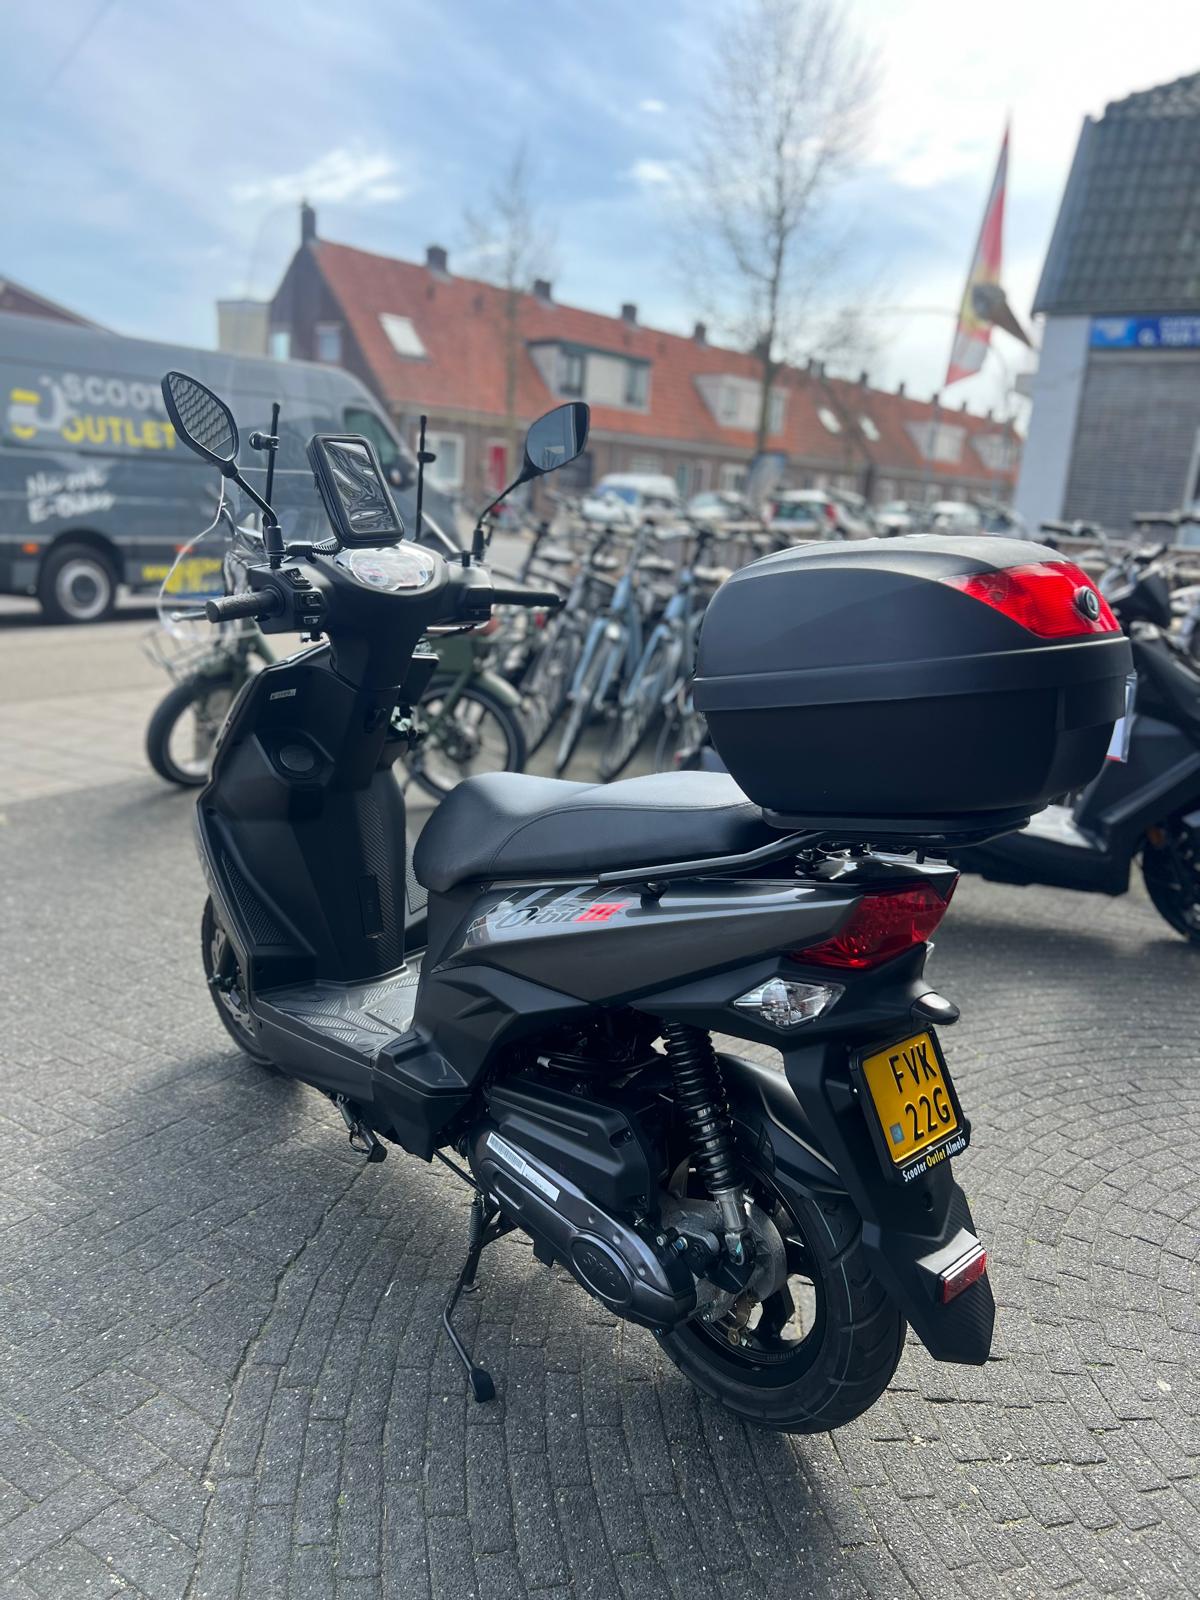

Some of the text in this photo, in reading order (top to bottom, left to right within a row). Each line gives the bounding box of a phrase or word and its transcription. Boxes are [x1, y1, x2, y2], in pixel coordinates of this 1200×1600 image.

[63, 416, 176, 448] OUTLET
[889, 1042, 937, 1094] FVK
[905, 1087, 950, 1141] 22G
[902, 1161, 927, 1182] Scooter
[926, 1148, 946, 1168] Outlet
[945, 1136, 966, 1156] Almelo
